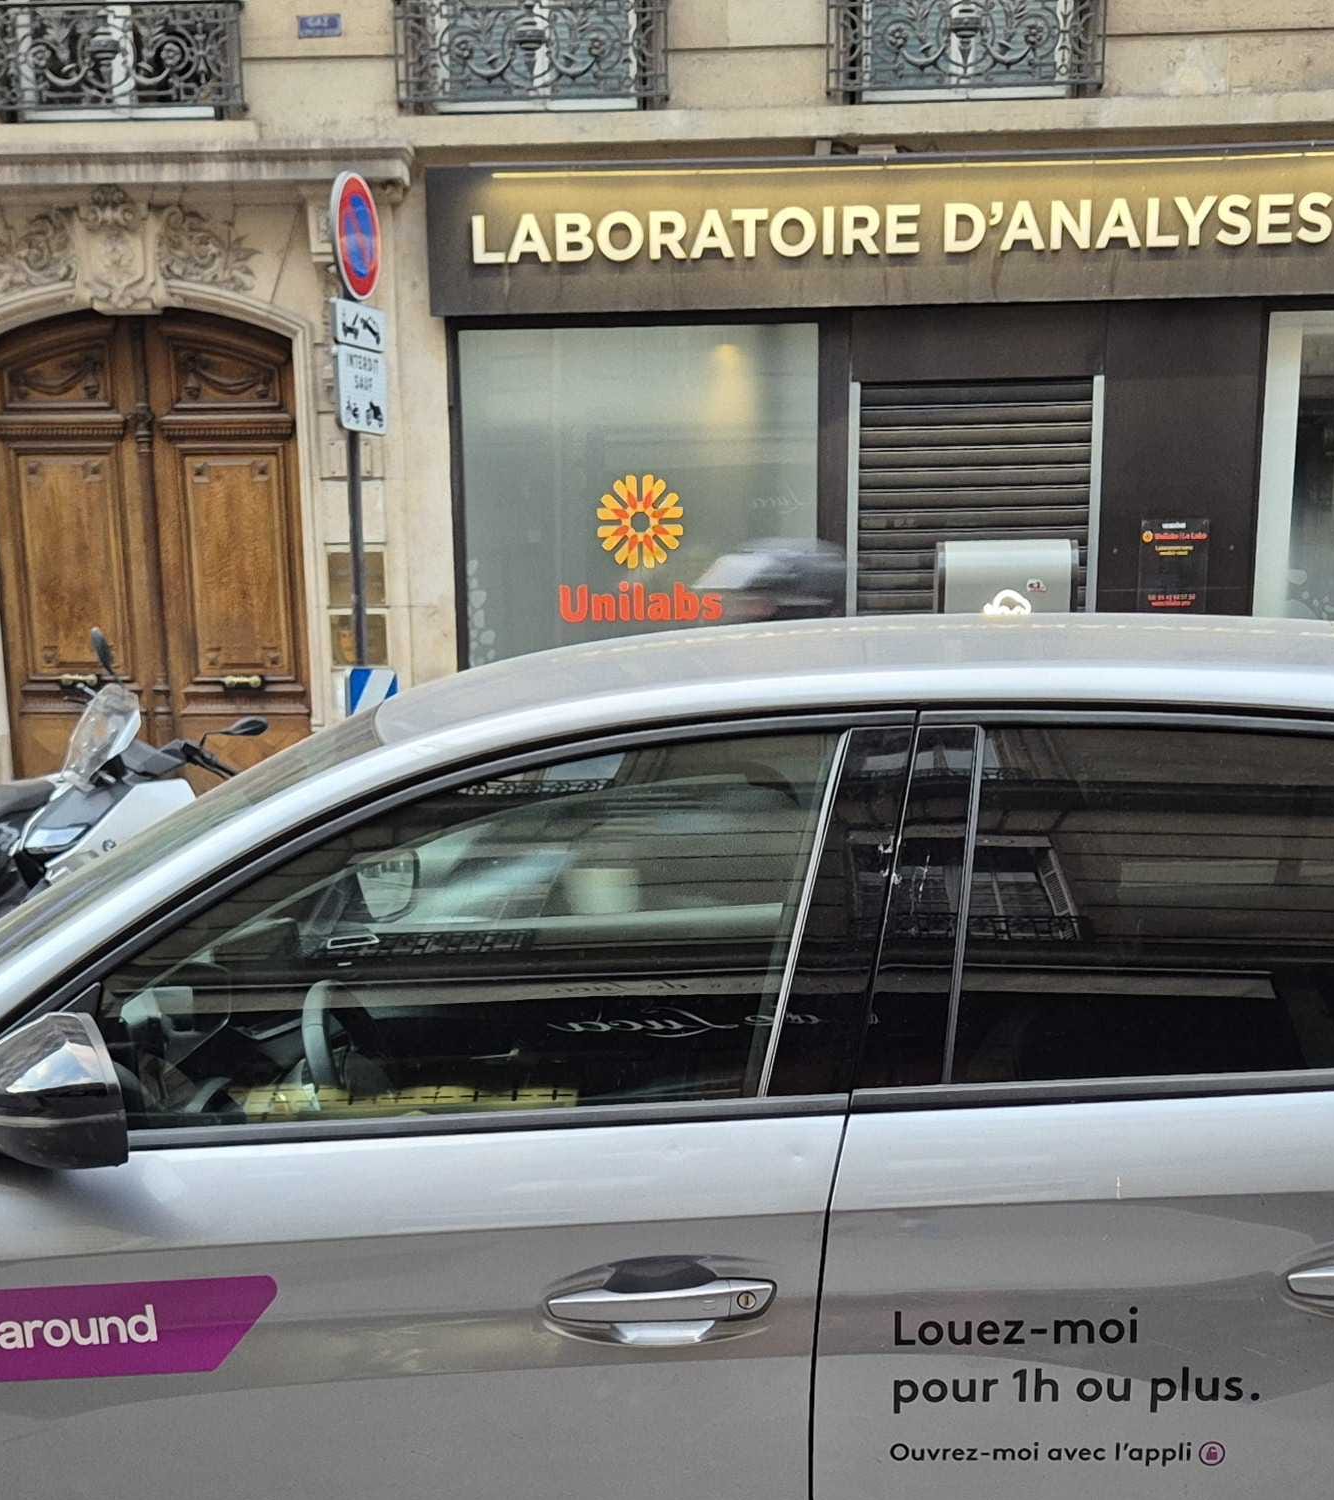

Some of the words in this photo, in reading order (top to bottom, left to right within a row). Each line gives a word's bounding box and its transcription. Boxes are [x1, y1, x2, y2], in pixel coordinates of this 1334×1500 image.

[471, 203, 921, 265] LABORATOIRE
[942, 191, 1334, 254] D'ANALYSES
[558, 580, 724, 624] Unilabs
[893, 1306, 1139, 1347] Louez-moi
[893, 1377, 999, 1414] pour
[1012, 1368, 1059, 1404] 1h
[1075, 1377, 1132, 1403] ou
[1149, 1366, 1261, 1414] plus.
[889, 1442, 1040, 1462] Ouvrez-moi
[1048, 1447, 1107, 1462] avec
[1114, 1442, 1193, 1468] l'appli
